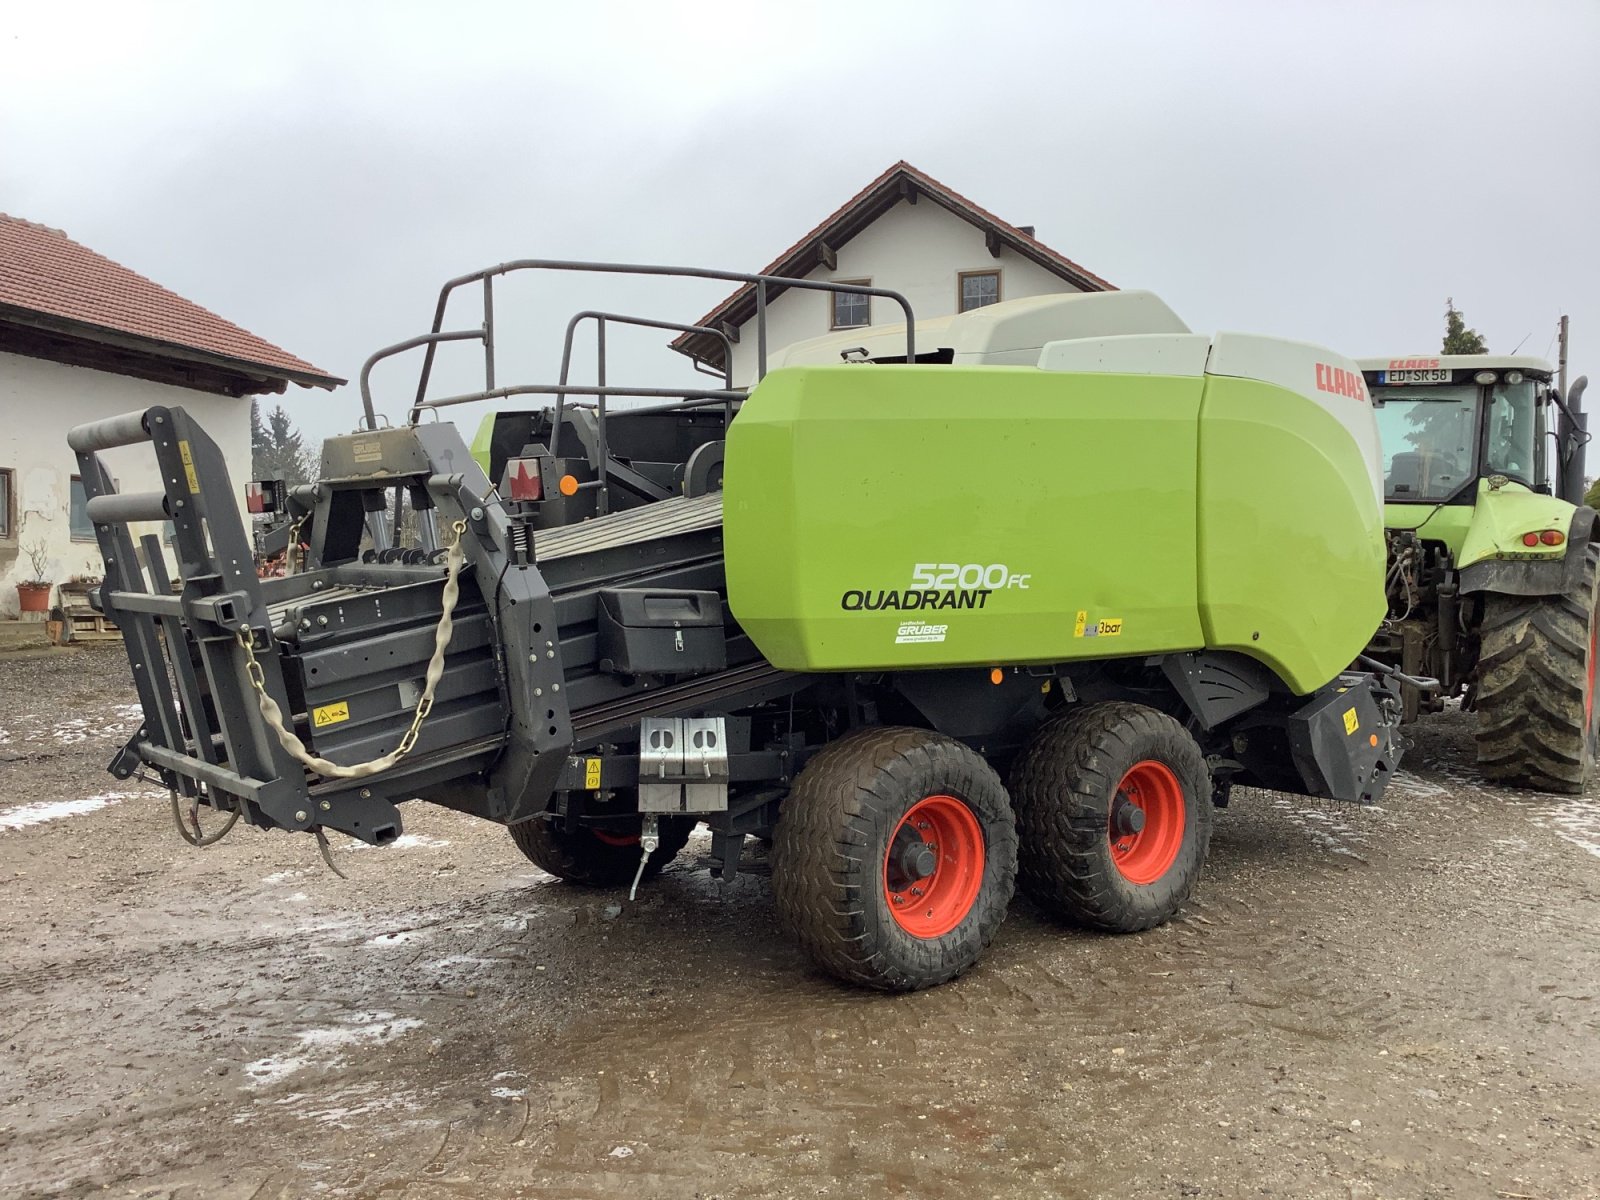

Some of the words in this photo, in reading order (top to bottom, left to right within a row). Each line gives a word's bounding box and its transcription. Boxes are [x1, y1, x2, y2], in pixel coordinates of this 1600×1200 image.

[1388, 360, 1440, 369] CLAAS
[1315, 362, 1365, 402] CLAAS
[1389, 370, 1405, 381] ED
[1413, 370, 1429, 381] SR
[1432, 370, 1447, 381] 58
[910, 563, 1008, 590] 5200
[1007, 574, 1031, 589] FC
[841, 590, 992, 611] QUADRANT
[897, 625, 949, 636] GRUBER
